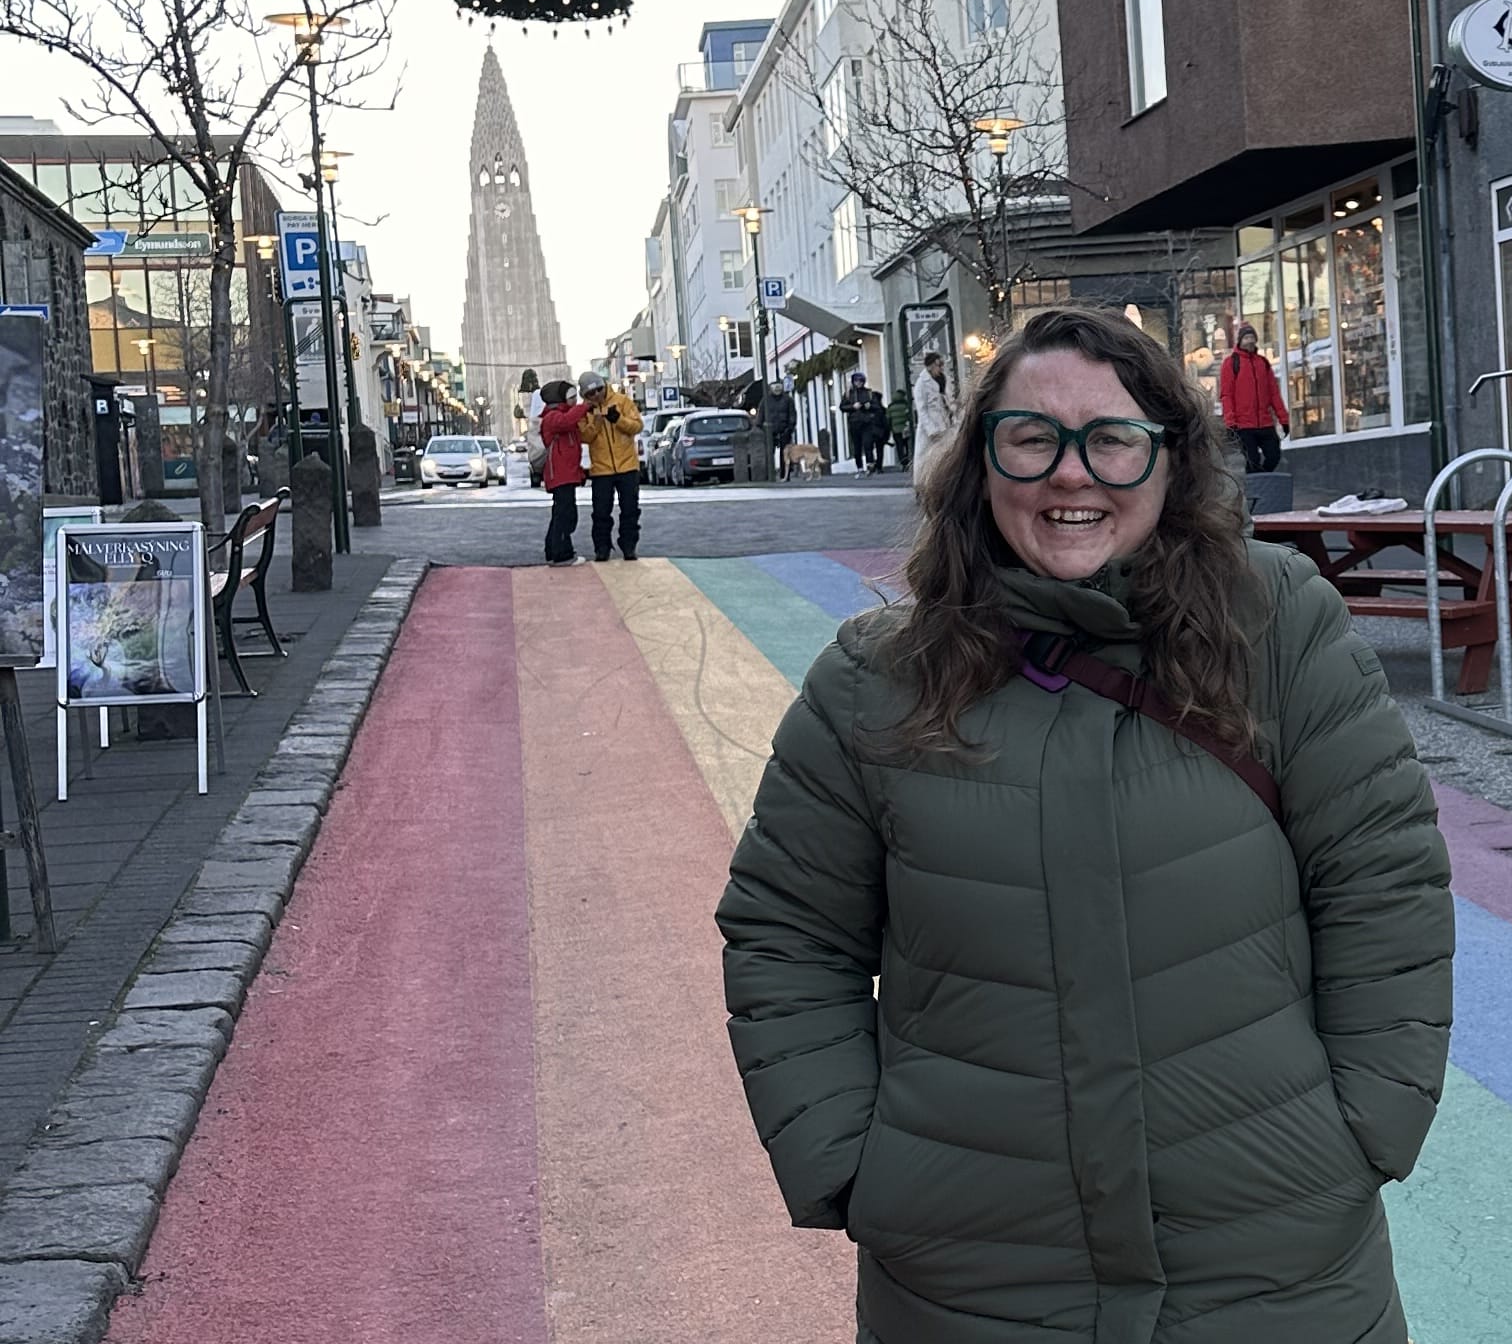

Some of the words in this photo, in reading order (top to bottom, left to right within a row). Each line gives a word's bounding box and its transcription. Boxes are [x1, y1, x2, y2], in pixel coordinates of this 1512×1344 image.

[296, 238, 316, 265] P
[768, 282, 780, 293] P
[665, 388, 675, 397] P
